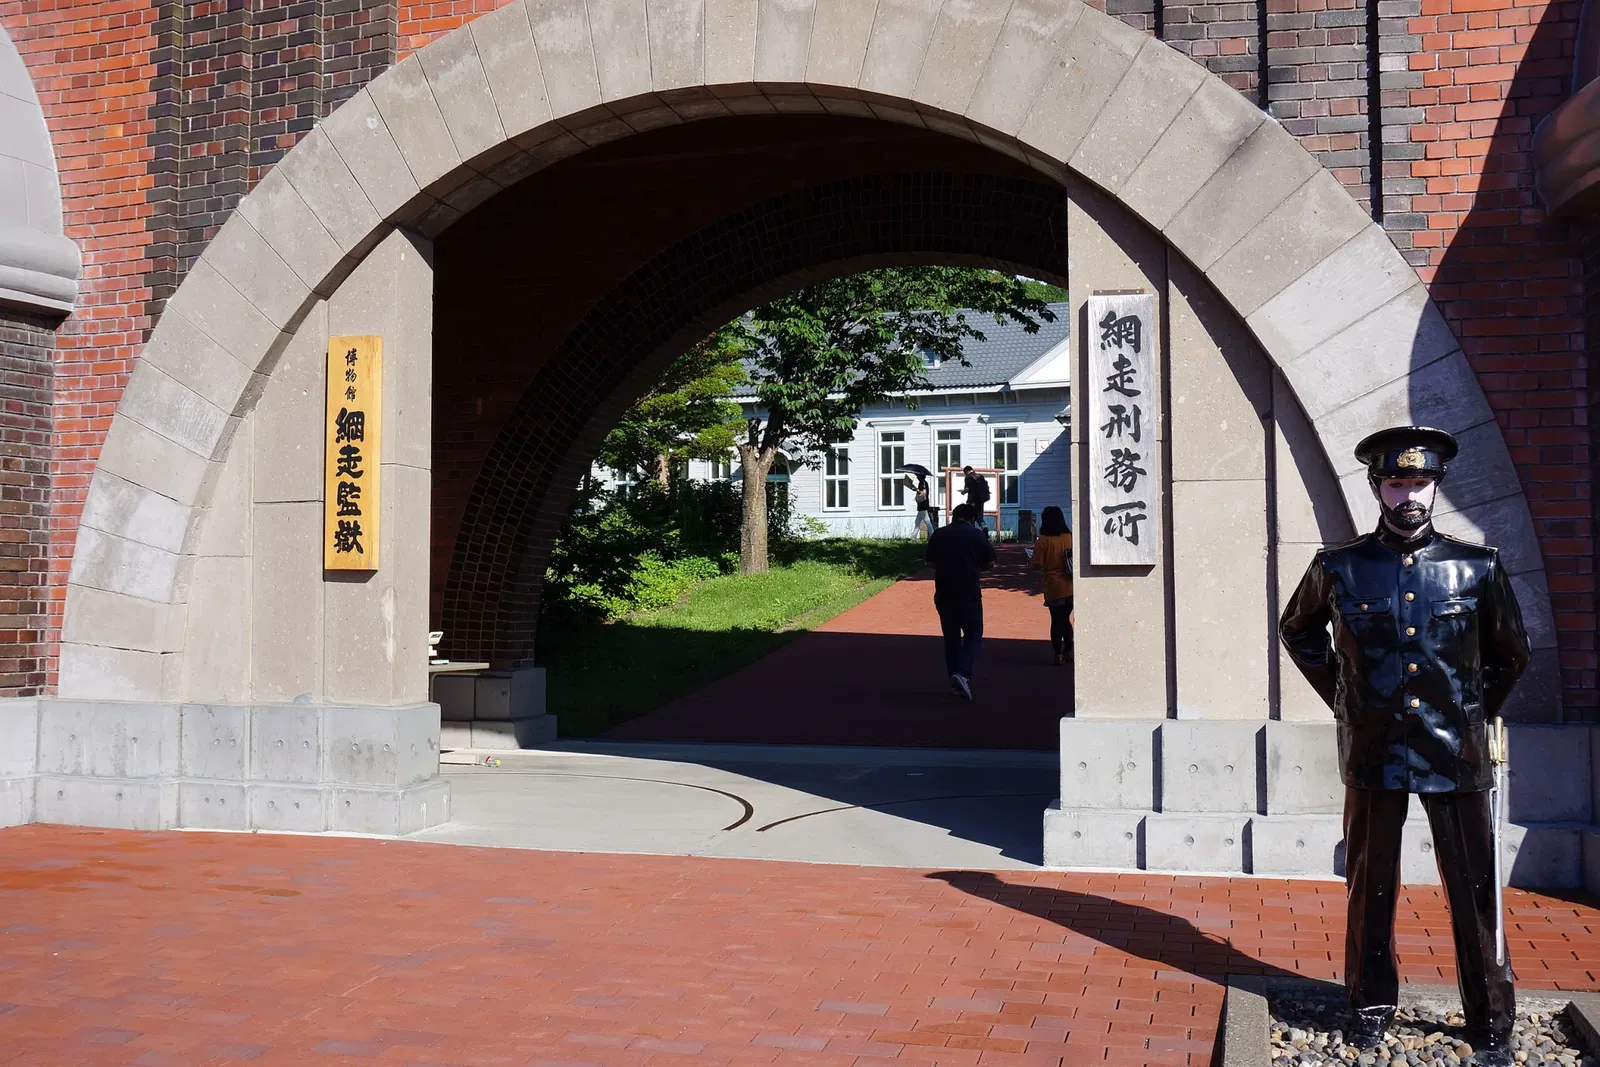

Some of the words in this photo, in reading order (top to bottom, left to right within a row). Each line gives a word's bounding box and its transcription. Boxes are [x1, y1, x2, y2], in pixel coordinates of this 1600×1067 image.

[345, 348, 358, 402] 博物館
[1099, 311, 1147, 545] 網走刑務所
[334, 407, 365, 554] 網走監獄
